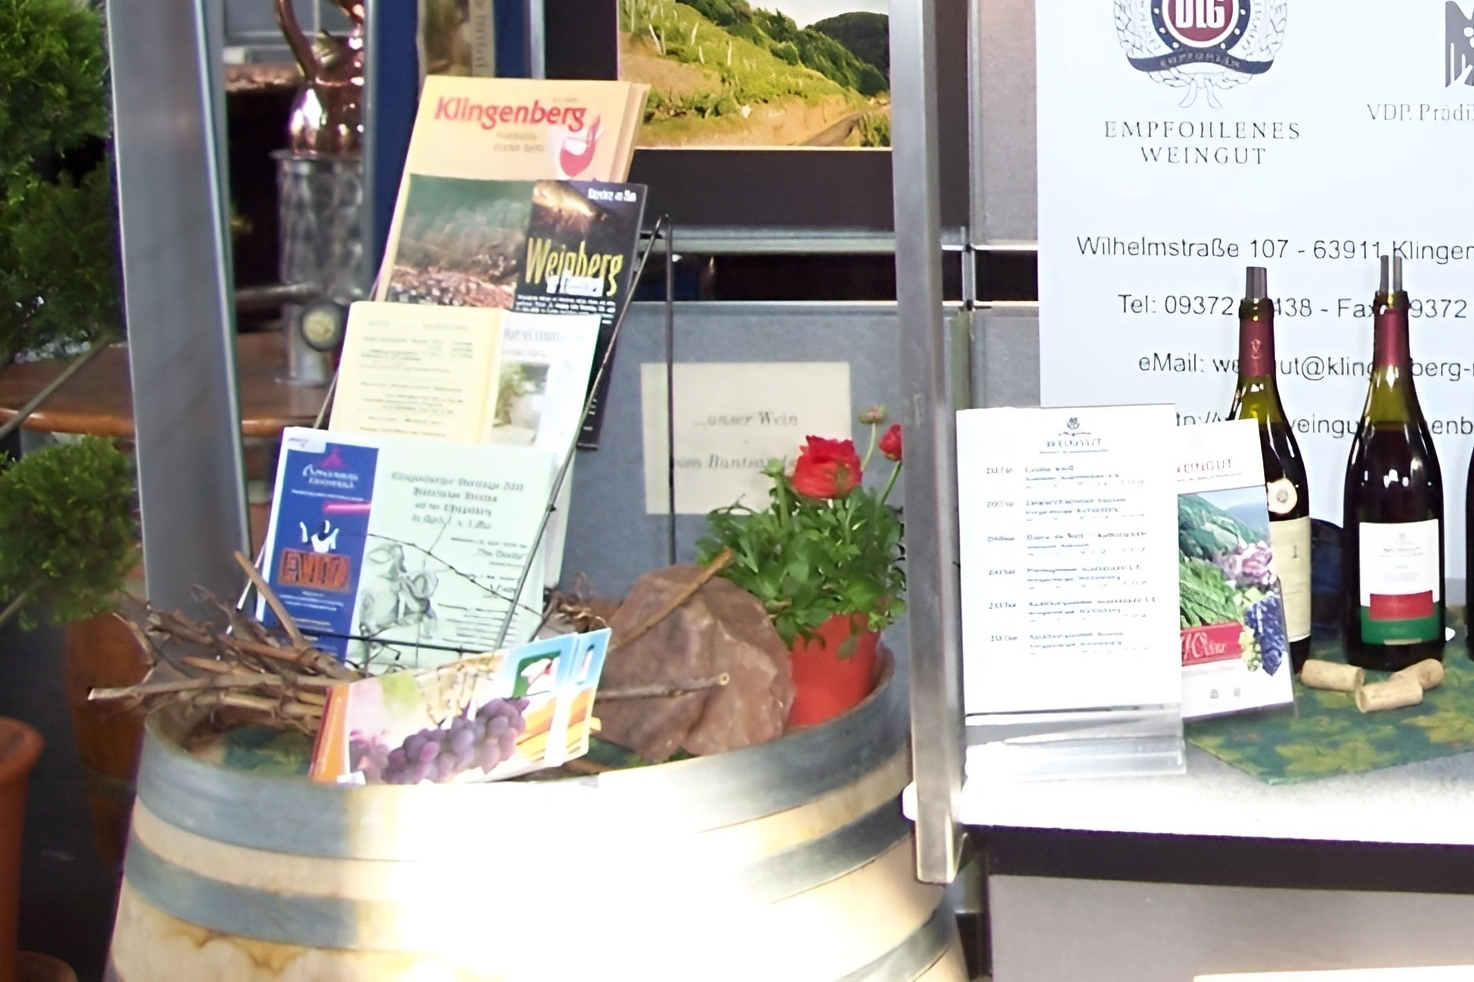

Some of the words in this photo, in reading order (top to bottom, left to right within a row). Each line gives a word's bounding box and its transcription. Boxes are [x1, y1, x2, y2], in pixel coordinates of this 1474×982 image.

[435, 96, 587, 133] Klingenberg
[1104, 120, 1301, 141] EMPFOHLENES
[1140, 146, 1267, 166] WEINGUT
[1076, 236, 1239, 258] Wilhelmstraße
[1250, 239, 1289, 258] 107
[1313, 239, 1381, 260] 63911
[525, 237, 623, 297] Weinberg
[1118, 294, 1157, 314] Tel:
[1164, 294, 1235, 317] 09372
